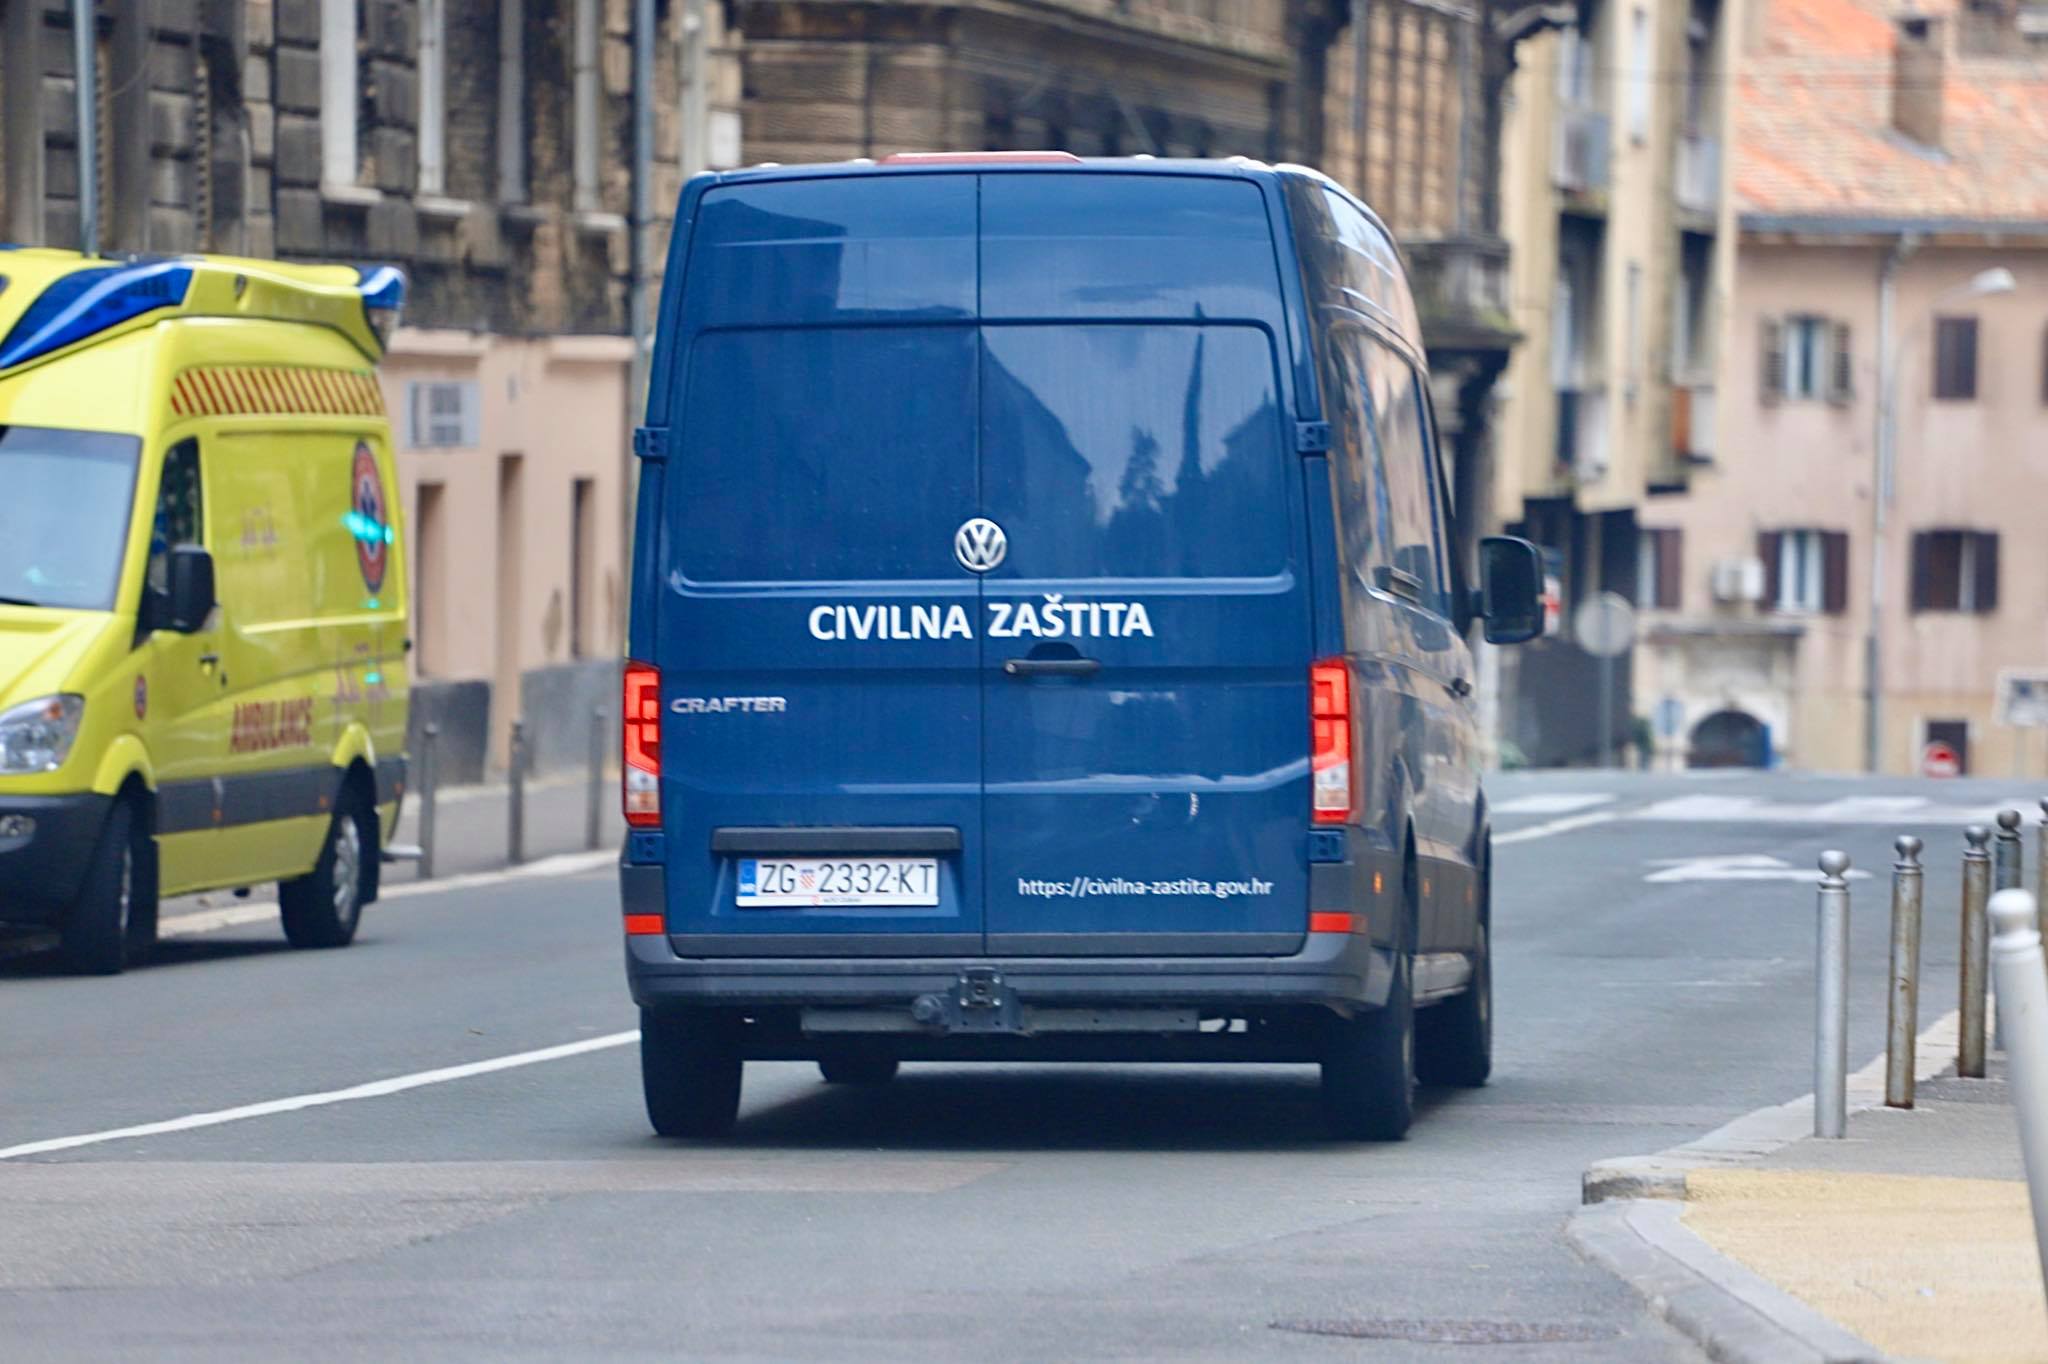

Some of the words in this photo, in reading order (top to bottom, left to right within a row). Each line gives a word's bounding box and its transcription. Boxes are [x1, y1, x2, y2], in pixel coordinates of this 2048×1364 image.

[808, 604, 973, 641] CIVILNA
[987, 593, 1154, 638] ZAŠTITA
[671, 696, 787, 713] CRAFTER
[761, 864, 796, 893] ZG
[1017, 877, 1274, 899] https://civilna-zastita.gov.hr
